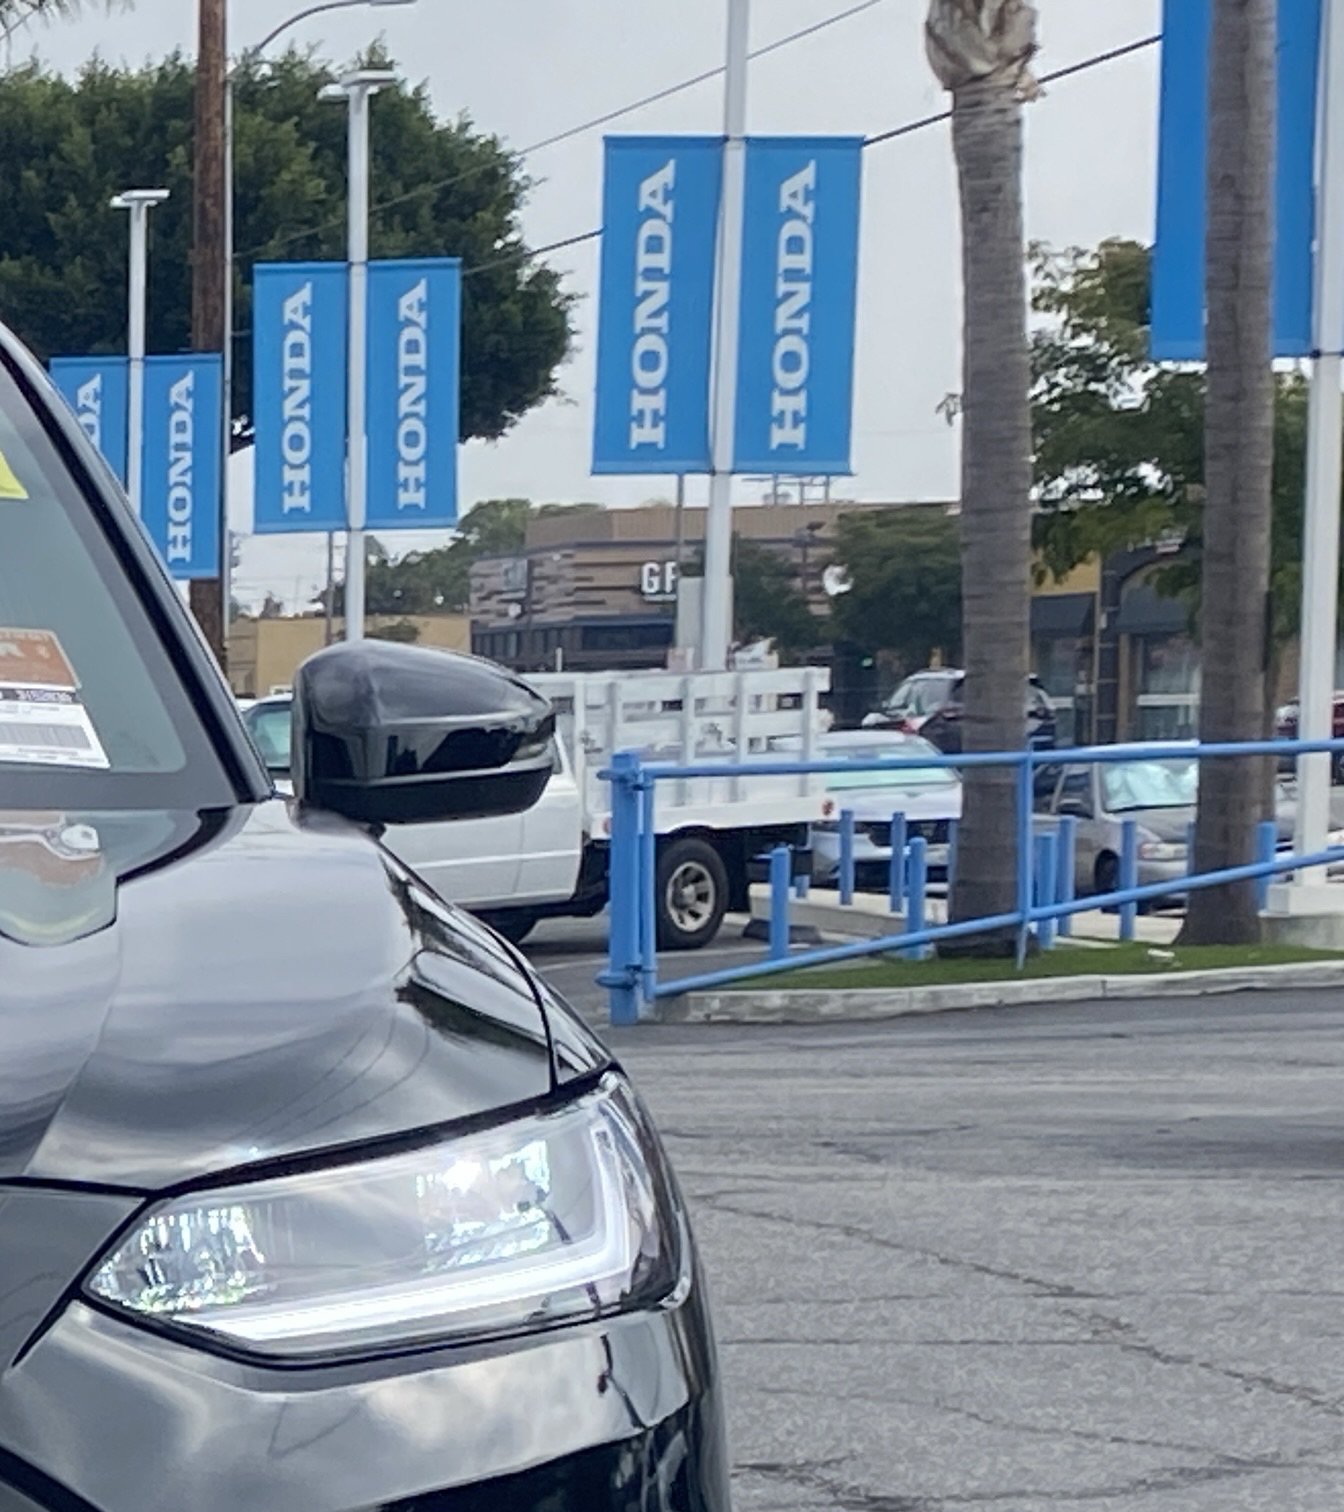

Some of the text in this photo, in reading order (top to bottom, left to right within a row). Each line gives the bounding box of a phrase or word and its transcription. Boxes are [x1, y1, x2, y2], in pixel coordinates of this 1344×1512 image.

[282, 282, 312, 516] HONDA
[397, 278, 429, 510] HONDA
[630, 159, 676, 451] HONDA
[770, 160, 816, 452] HONDA
[167, 370, 195, 563] HONDA
